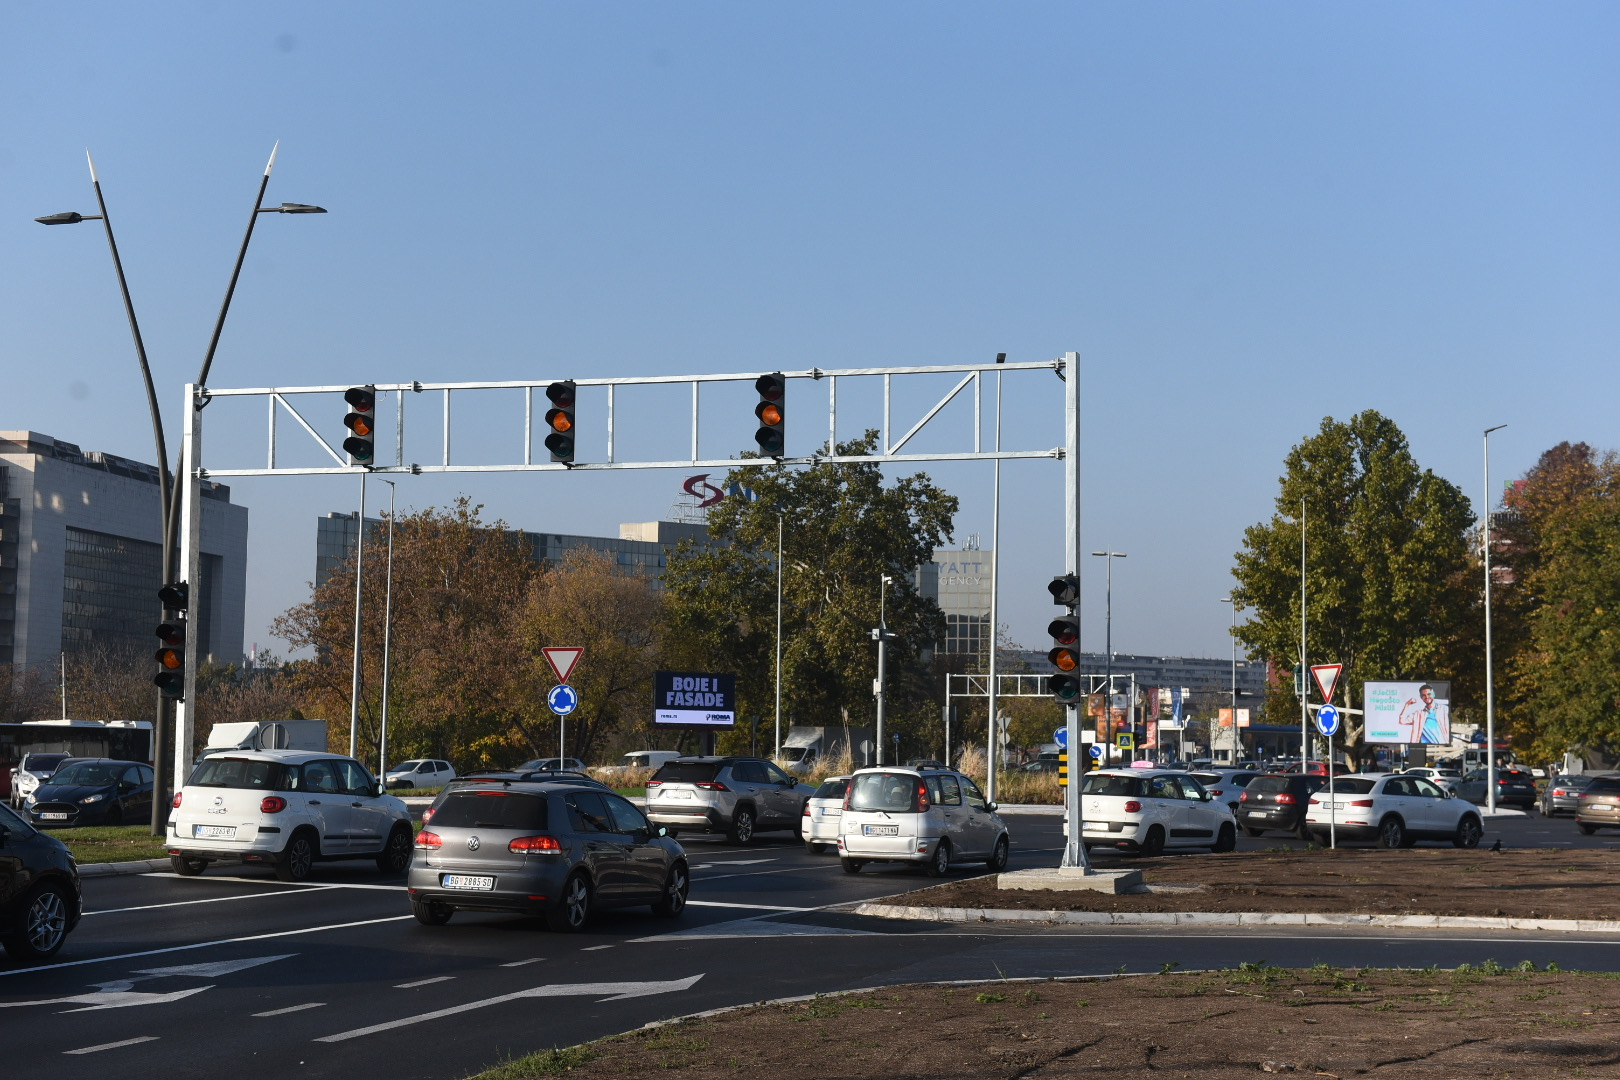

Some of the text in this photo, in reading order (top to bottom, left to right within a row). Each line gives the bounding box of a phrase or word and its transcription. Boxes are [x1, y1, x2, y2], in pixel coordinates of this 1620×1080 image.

[938, 562, 982, 574] YATT
[939, 576, 982, 585] GENCY
[672, 676, 718, 692] BOJE I
[666, 692, 724, 707] FASADE
[450, 876, 459, 885] BG
[482, 878, 492, 886] SD
